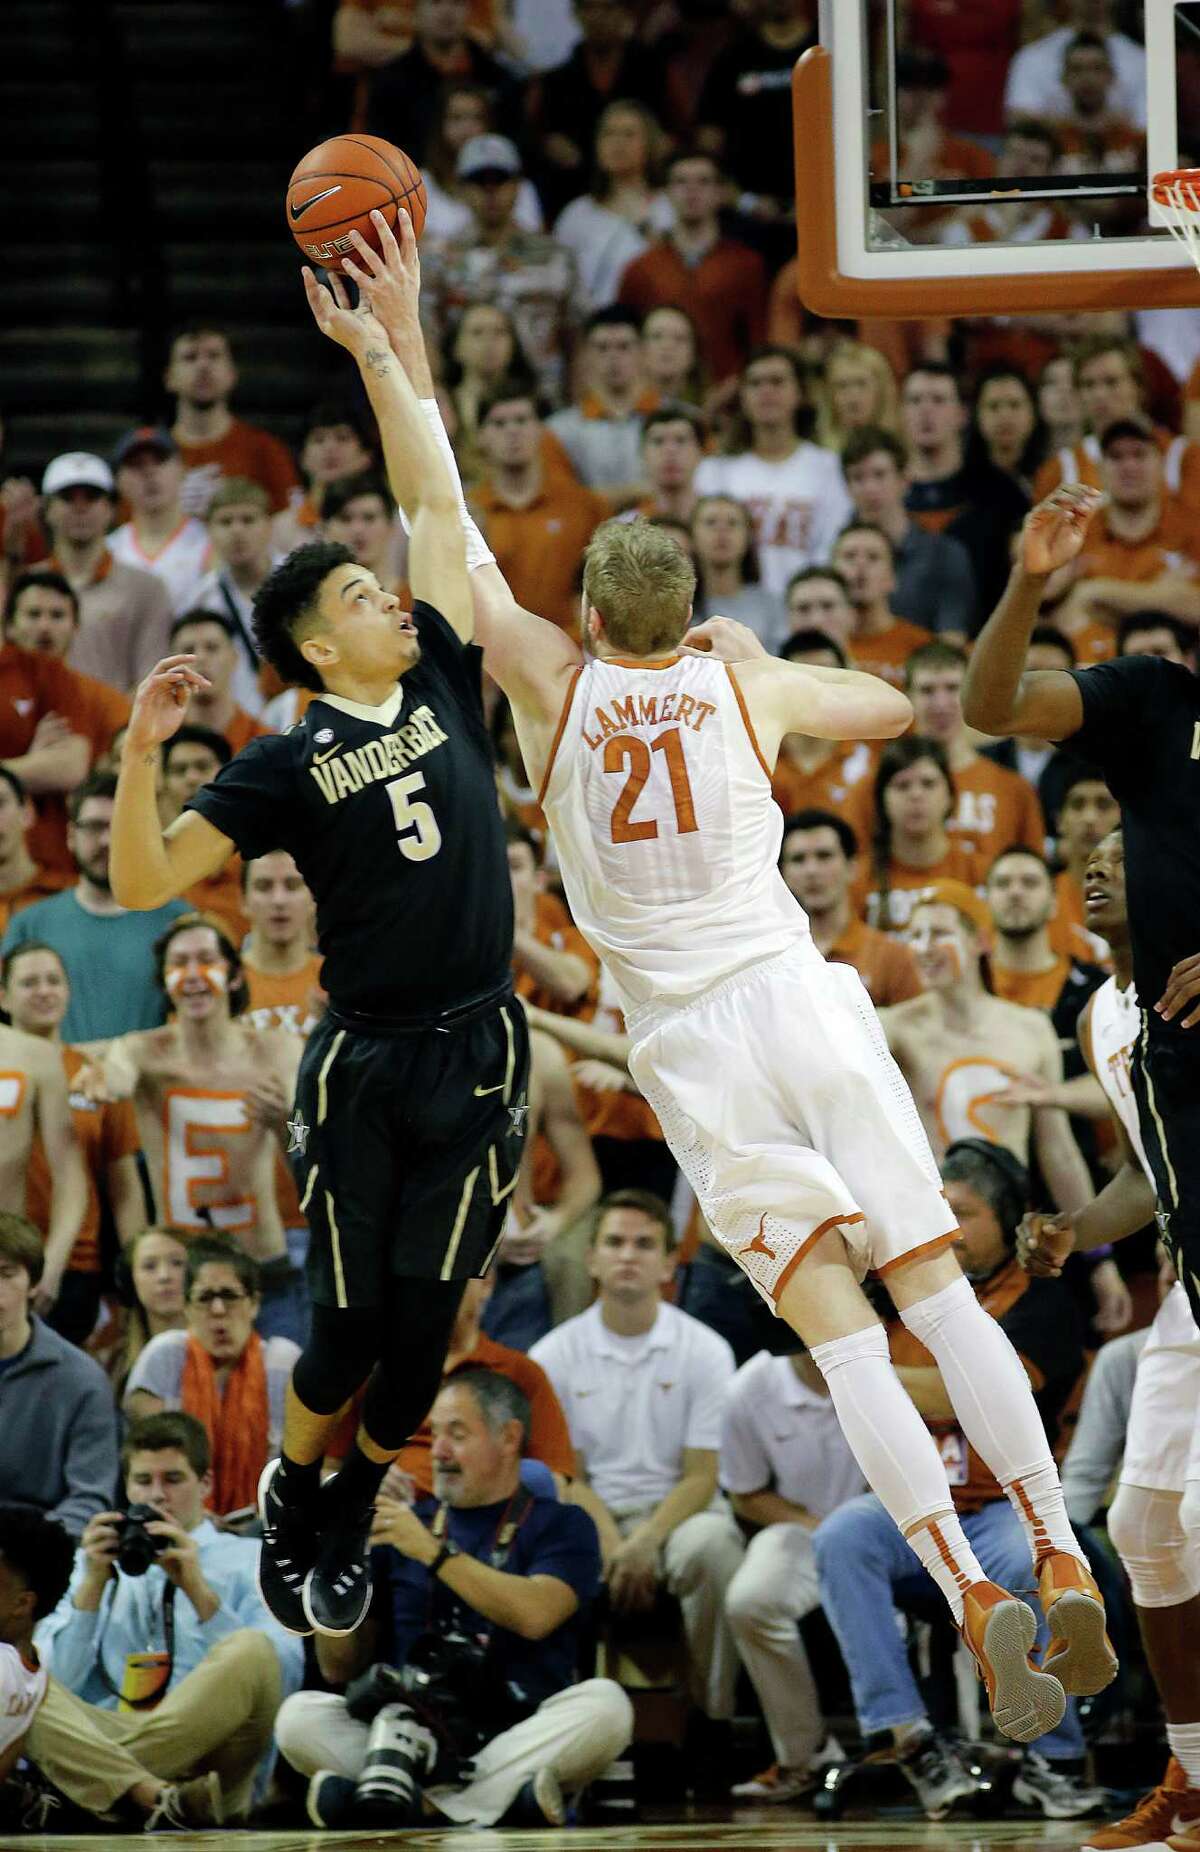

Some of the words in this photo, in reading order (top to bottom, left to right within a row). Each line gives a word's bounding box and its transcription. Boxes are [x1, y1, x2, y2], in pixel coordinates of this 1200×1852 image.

[582, 693, 716, 751] LAMMERT
[385, 771, 442, 861] 5
[603, 728, 699, 844] 21
[163, 1088, 257, 1232] E
